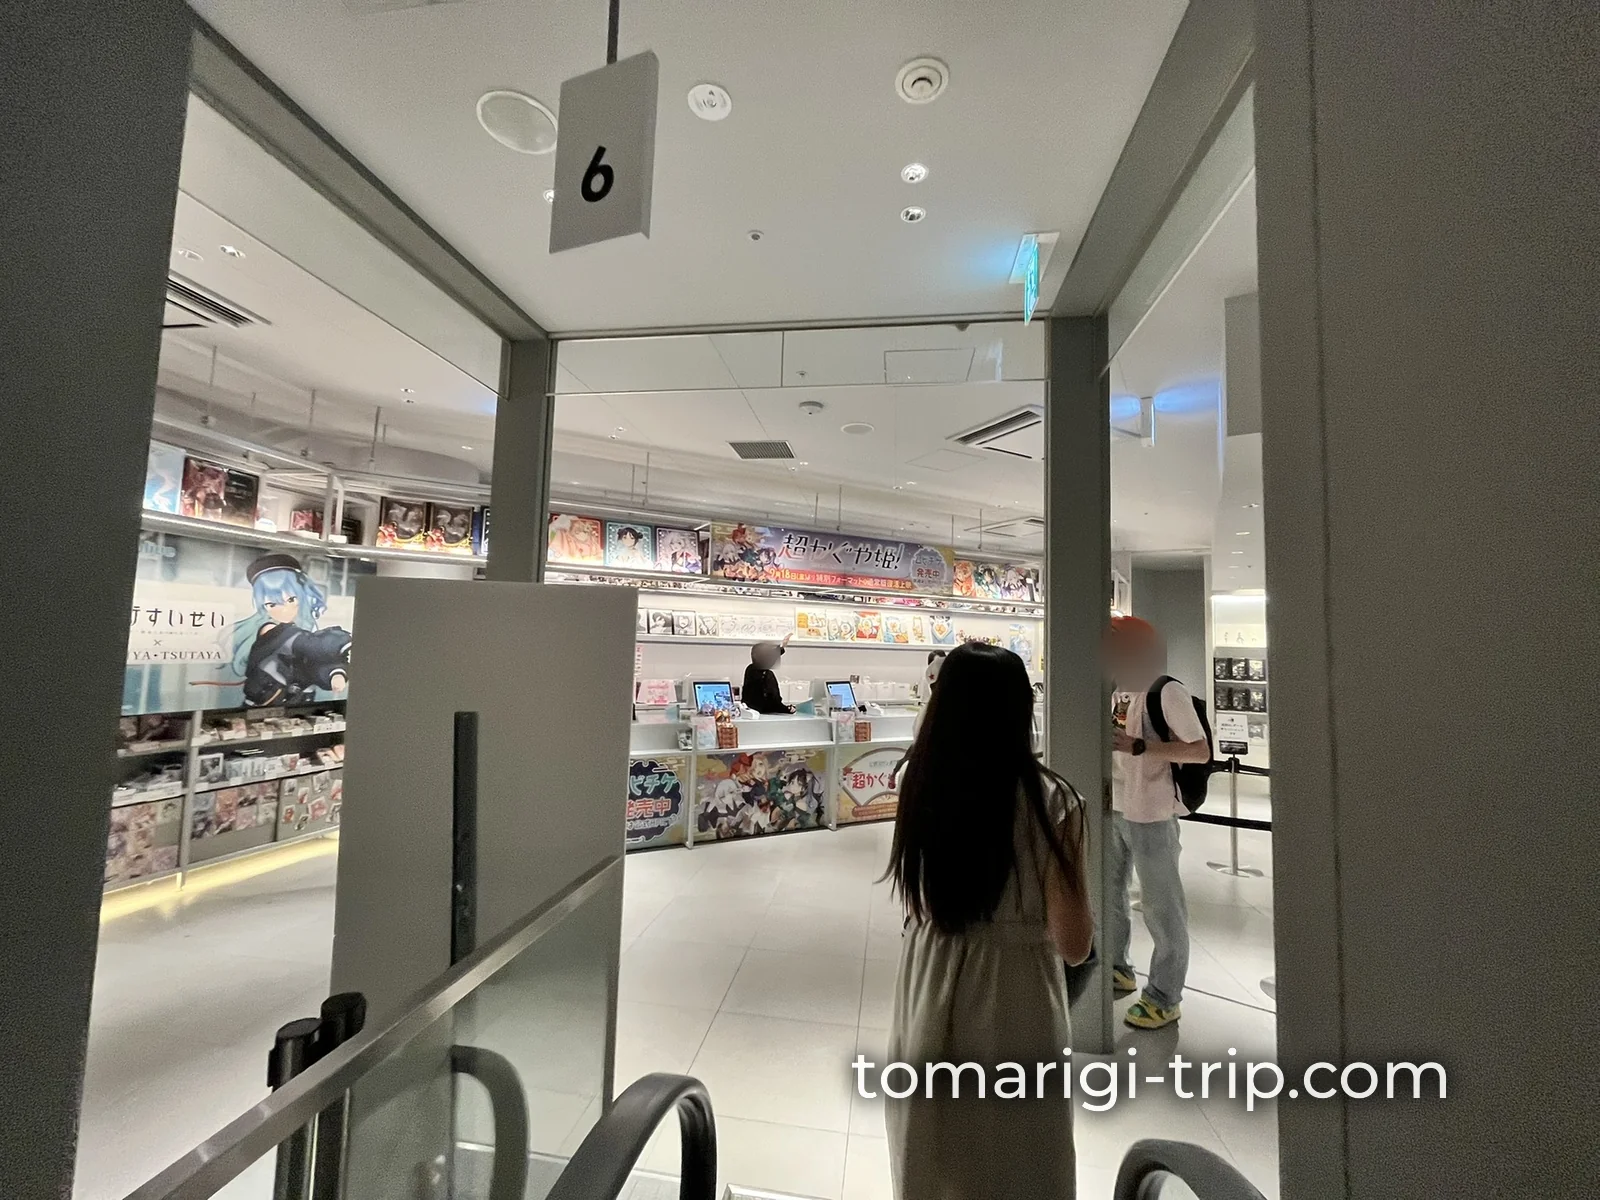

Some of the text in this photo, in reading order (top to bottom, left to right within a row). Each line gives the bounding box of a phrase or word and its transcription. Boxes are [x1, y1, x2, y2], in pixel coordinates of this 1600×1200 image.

[581, 145, 614, 203] 6
[916, 567, 940, 579] 発売中
[852, 772, 895, 789] 超かぐ
